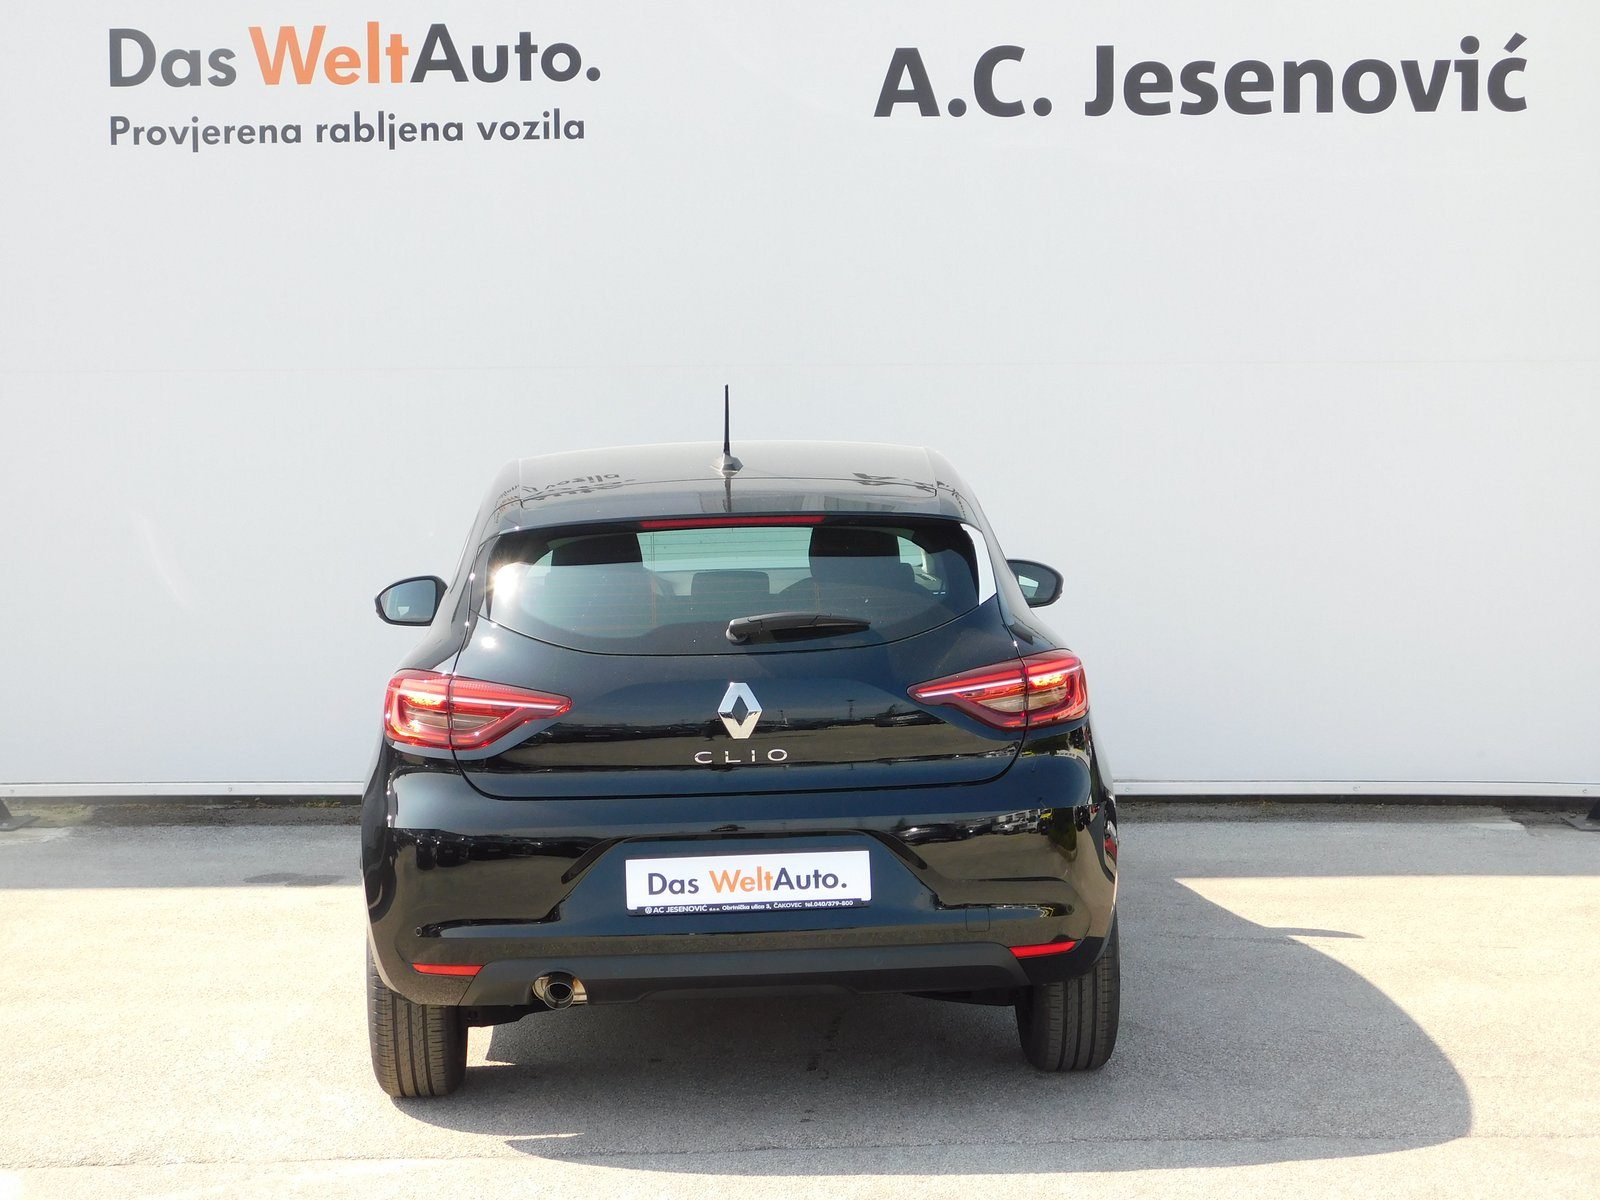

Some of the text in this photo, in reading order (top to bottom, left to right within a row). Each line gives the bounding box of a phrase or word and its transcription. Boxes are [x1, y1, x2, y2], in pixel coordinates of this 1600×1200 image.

[109, 21, 601, 88] Das WeltAuto.
[873, 32, 1528, 118] A.C. Jesenović
[110, 108, 585, 153] Provjerena rabljena vozila
[694, 748, 788, 764] CLIO
[647, 866, 848, 896] Das WeltAuto.
[666, 904, 708, 913] JESENOVIĆ
[774, 901, 802, 909] ČAKOVEC
